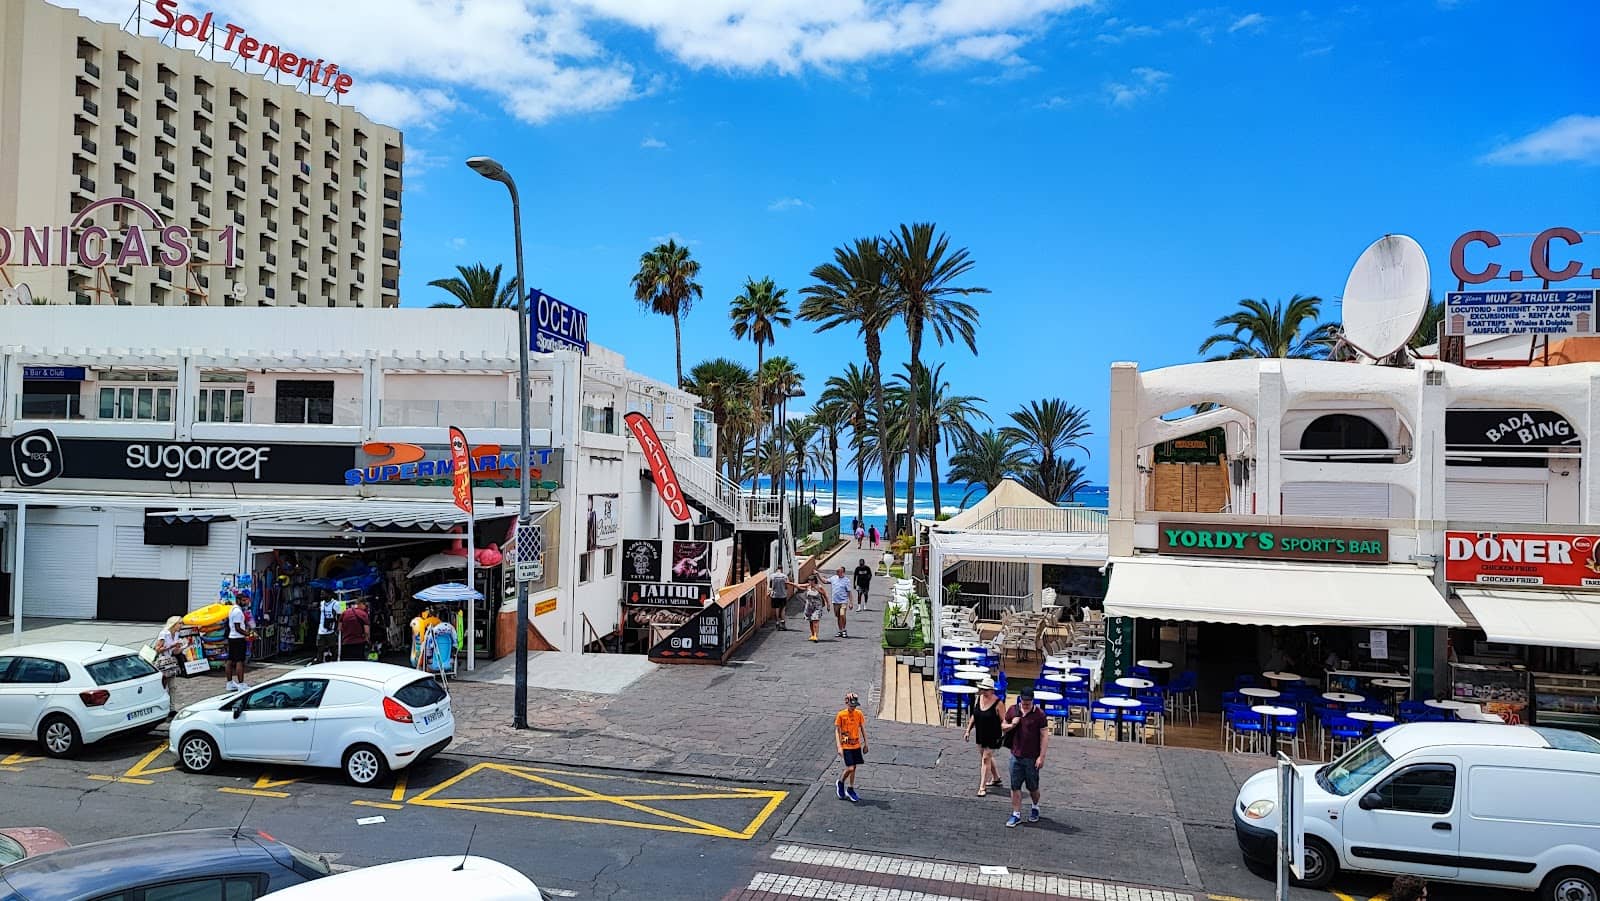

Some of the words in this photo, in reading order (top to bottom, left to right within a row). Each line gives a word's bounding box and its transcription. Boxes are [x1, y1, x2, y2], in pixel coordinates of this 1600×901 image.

[150, 0, 213, 42] Sol
[223, 23, 353, 94] Tenerife
[218, 225, 236, 267] 1
[1485, 294, 1507, 303] MUN
[1509, 293, 1522, 304] 2
[1524, 293, 1560, 302] TRAVEL
[537, 295, 587, 343] OCEAN
[1472, 326, 1510, 334] AUSFLÜGE
[1546, 320, 1573, 328] Dolphins
[1486, 412, 1534, 442] BADA
[1516, 420, 1570, 444] BING
[126, 444, 271, 479] sugareef
[634, 418, 683, 517] TATTOO
[1350, 540, 1382, 554] BAR
[1447, 532, 1573, 565] DÖNER
[640, 584, 699, 600] TATTOO
